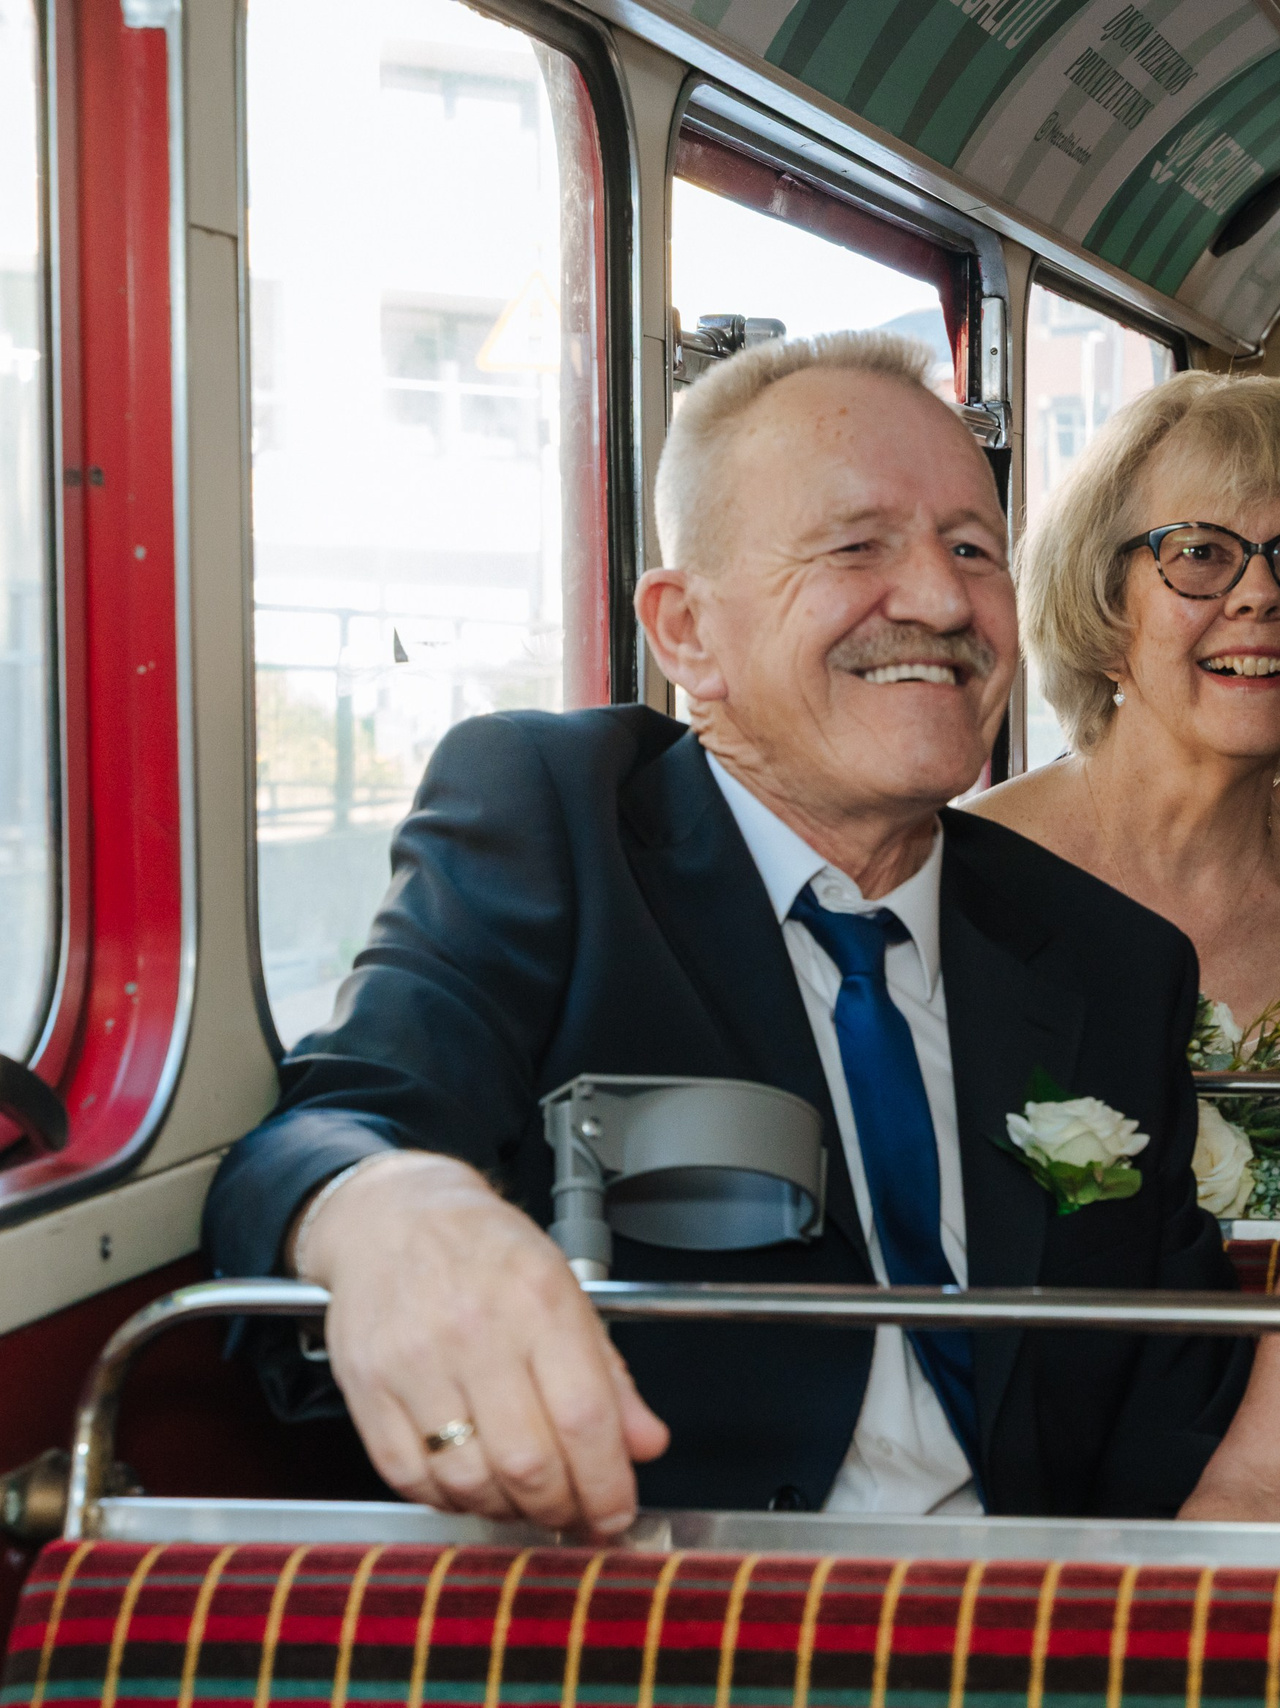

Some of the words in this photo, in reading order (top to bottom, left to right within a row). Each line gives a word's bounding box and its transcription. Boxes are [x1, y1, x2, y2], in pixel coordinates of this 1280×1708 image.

[1063, 46, 1125, 105] PRIVATE
[1102, 81, 1155, 130] EVENTS
[1133, 30, 1198, 96] WEEKENDS
[1174, 132, 1265, 216] MEZCALITO
